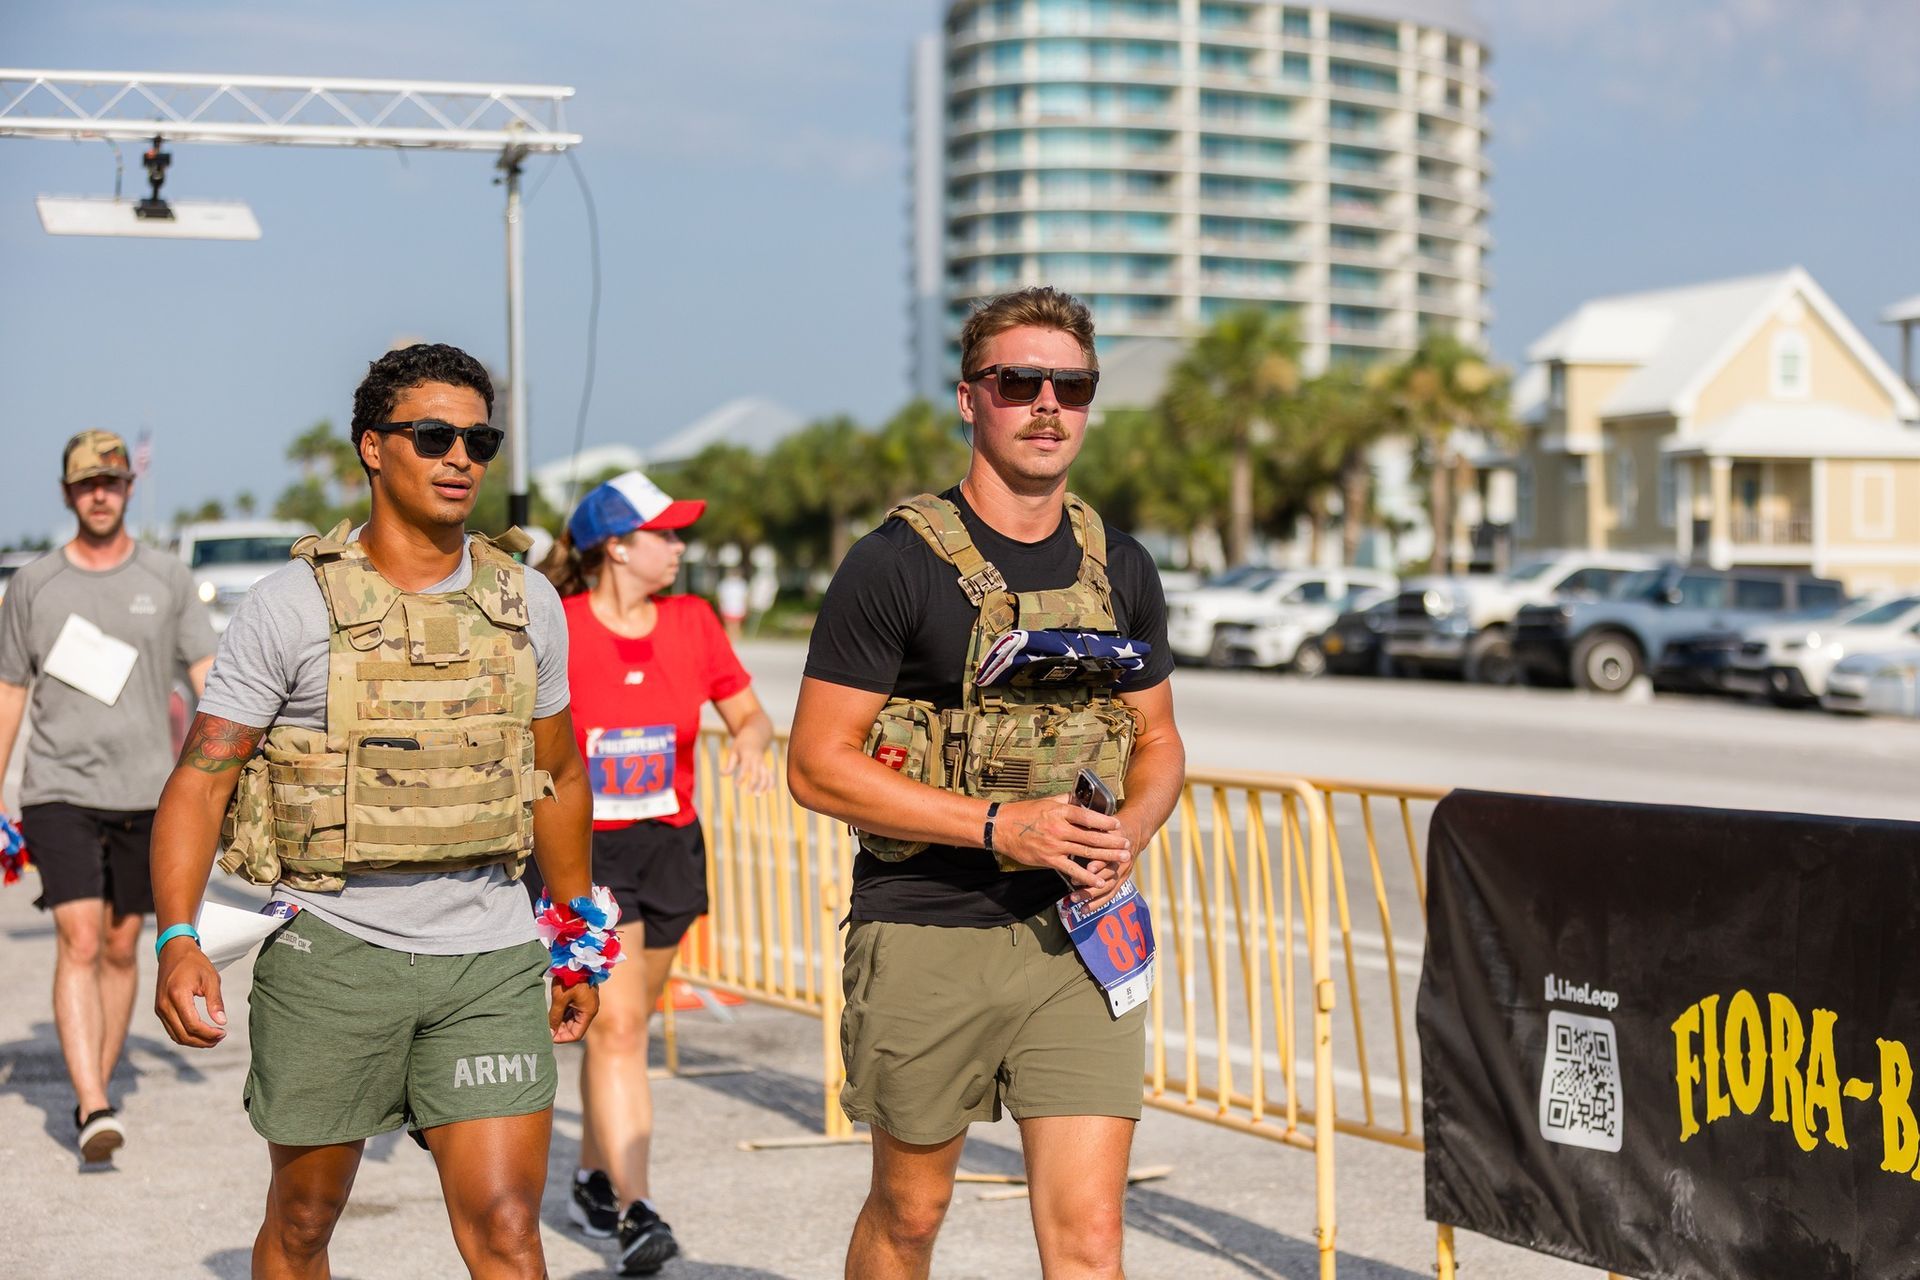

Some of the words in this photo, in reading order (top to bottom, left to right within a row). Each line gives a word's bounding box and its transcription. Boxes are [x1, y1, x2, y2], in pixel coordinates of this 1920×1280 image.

[601, 754, 665, 795] 123
[1097, 901, 1147, 972] 85
[1558, 978, 1619, 1012] LineLeap
[454, 1053, 538, 1089] ARMY
[1671, 989, 1920, 1181] FLORA-B
